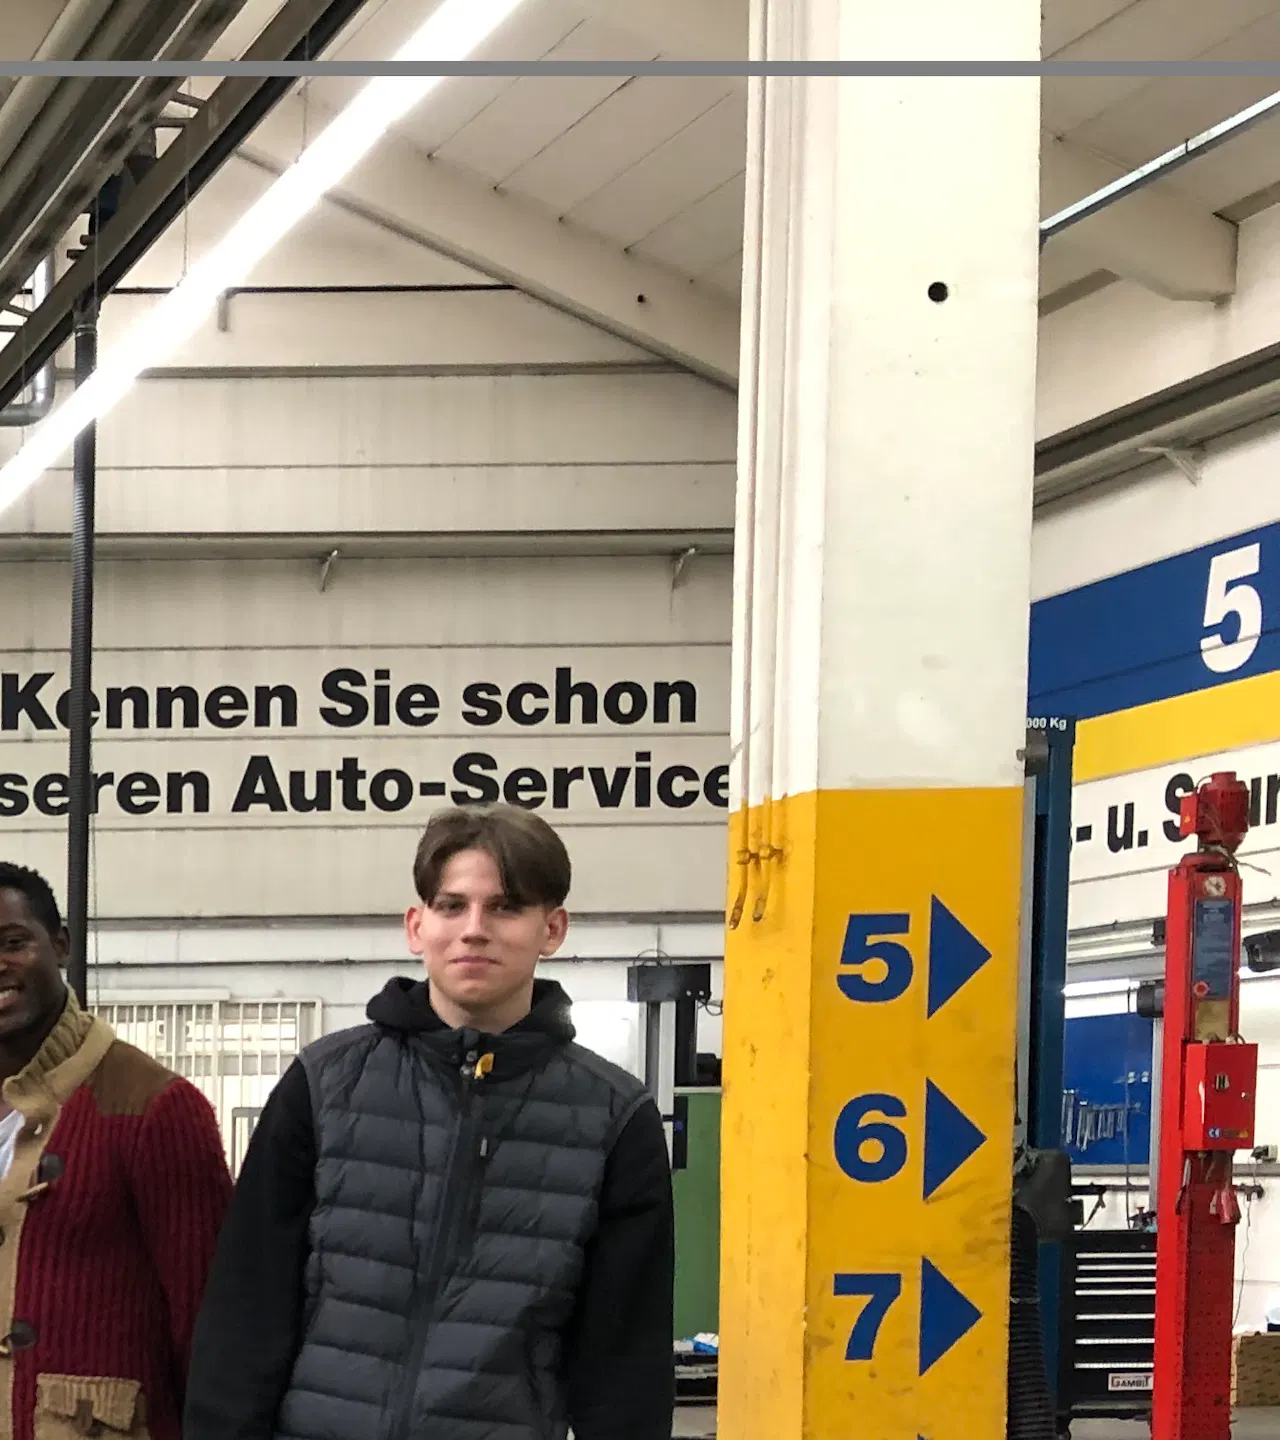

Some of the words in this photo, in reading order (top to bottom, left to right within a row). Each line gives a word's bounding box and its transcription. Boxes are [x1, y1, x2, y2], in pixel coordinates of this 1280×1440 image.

[1199, 542, 1262, 674] 5
[0, 672, 297, 731] Kennen
[318, 667, 440, 727] Sie
[461, 666, 698, 726] schon
[1050, 716, 1067, 731] Kg
[231, 750, 731, 815] Auto-Service
[1107, 802, 1149, 853] u.
[837, 913, 914, 1003] 5
[834, 1093, 908, 1183] 6
[833, 1273, 902, 1361] 7
[1111, 1375, 1152, 1388] GAMBIT
